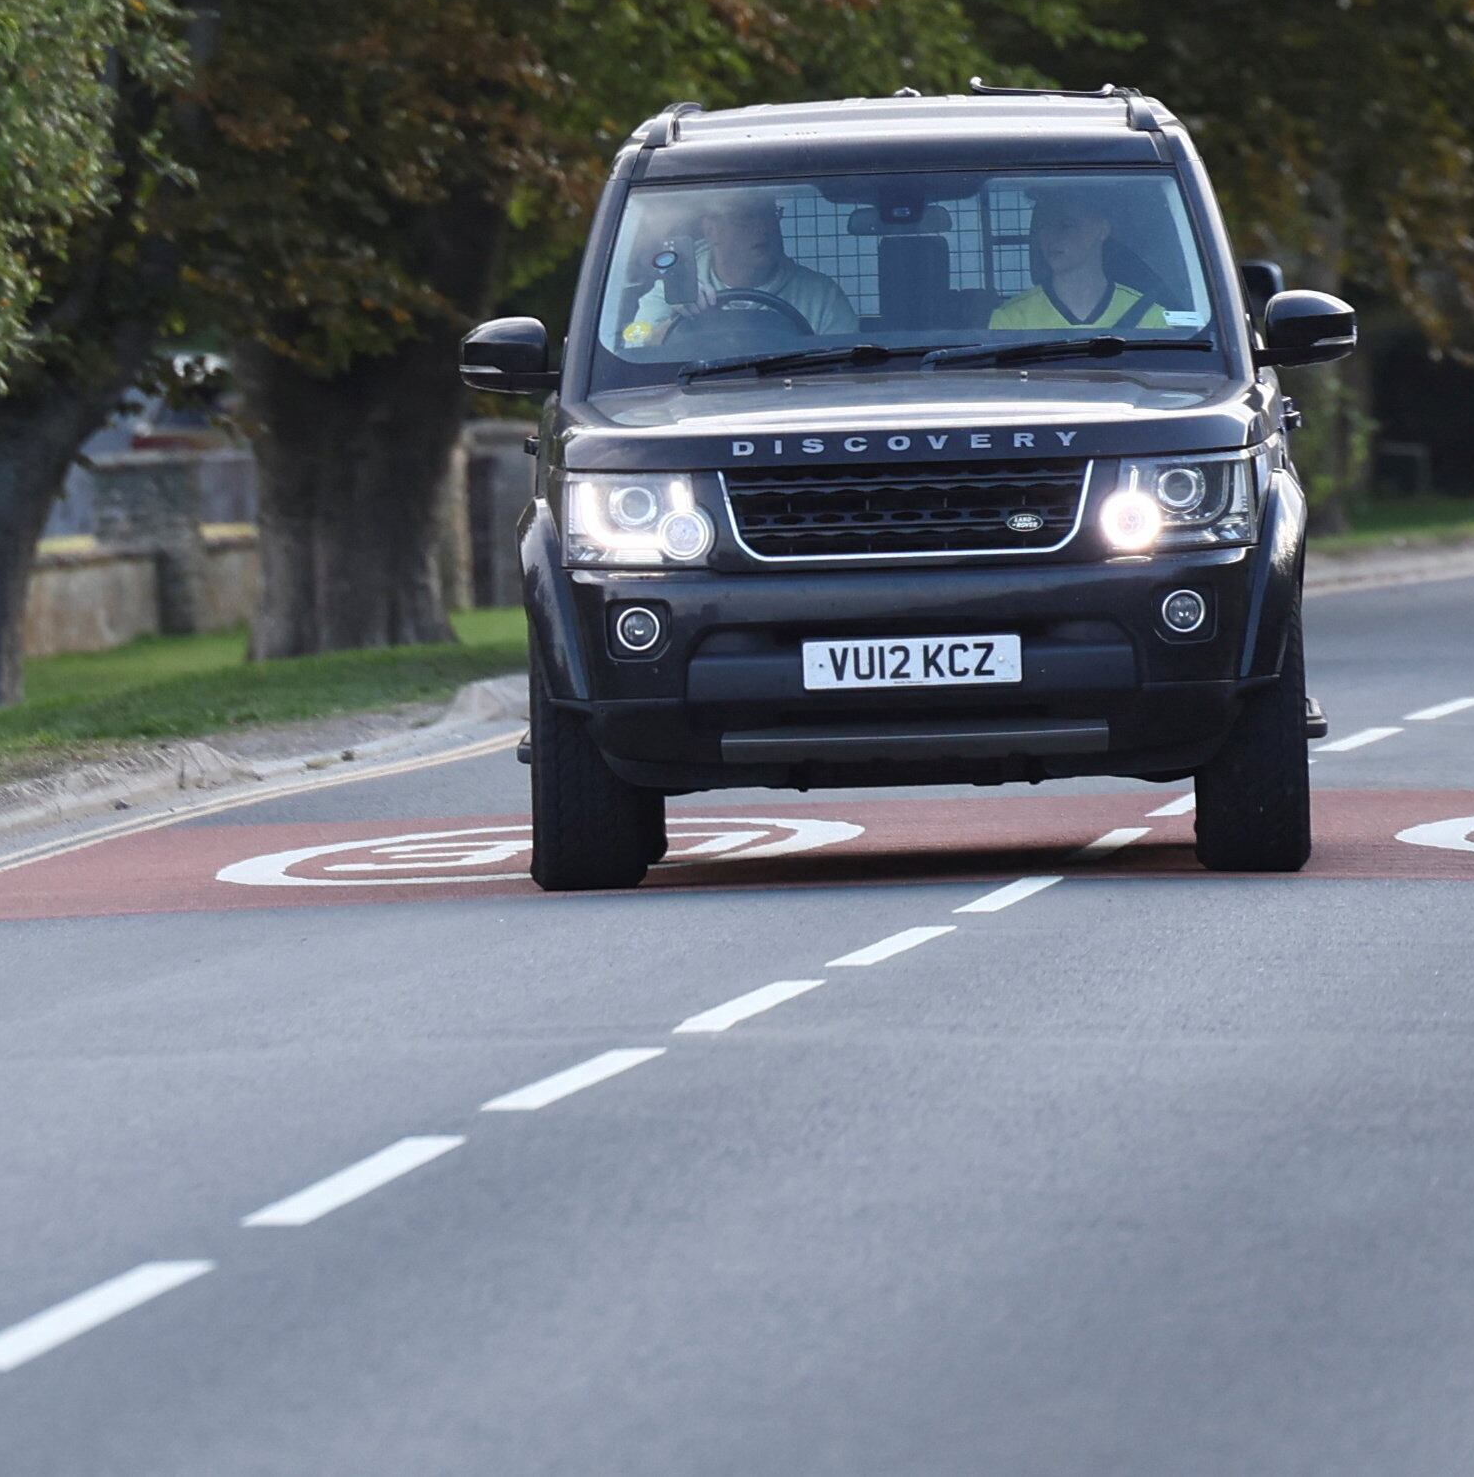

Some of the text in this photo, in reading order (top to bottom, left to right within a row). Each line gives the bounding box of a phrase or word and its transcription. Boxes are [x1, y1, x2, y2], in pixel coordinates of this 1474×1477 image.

[731, 431, 1078, 457] DISCOVERY
[828, 642, 996, 682] VU12 KCZ
